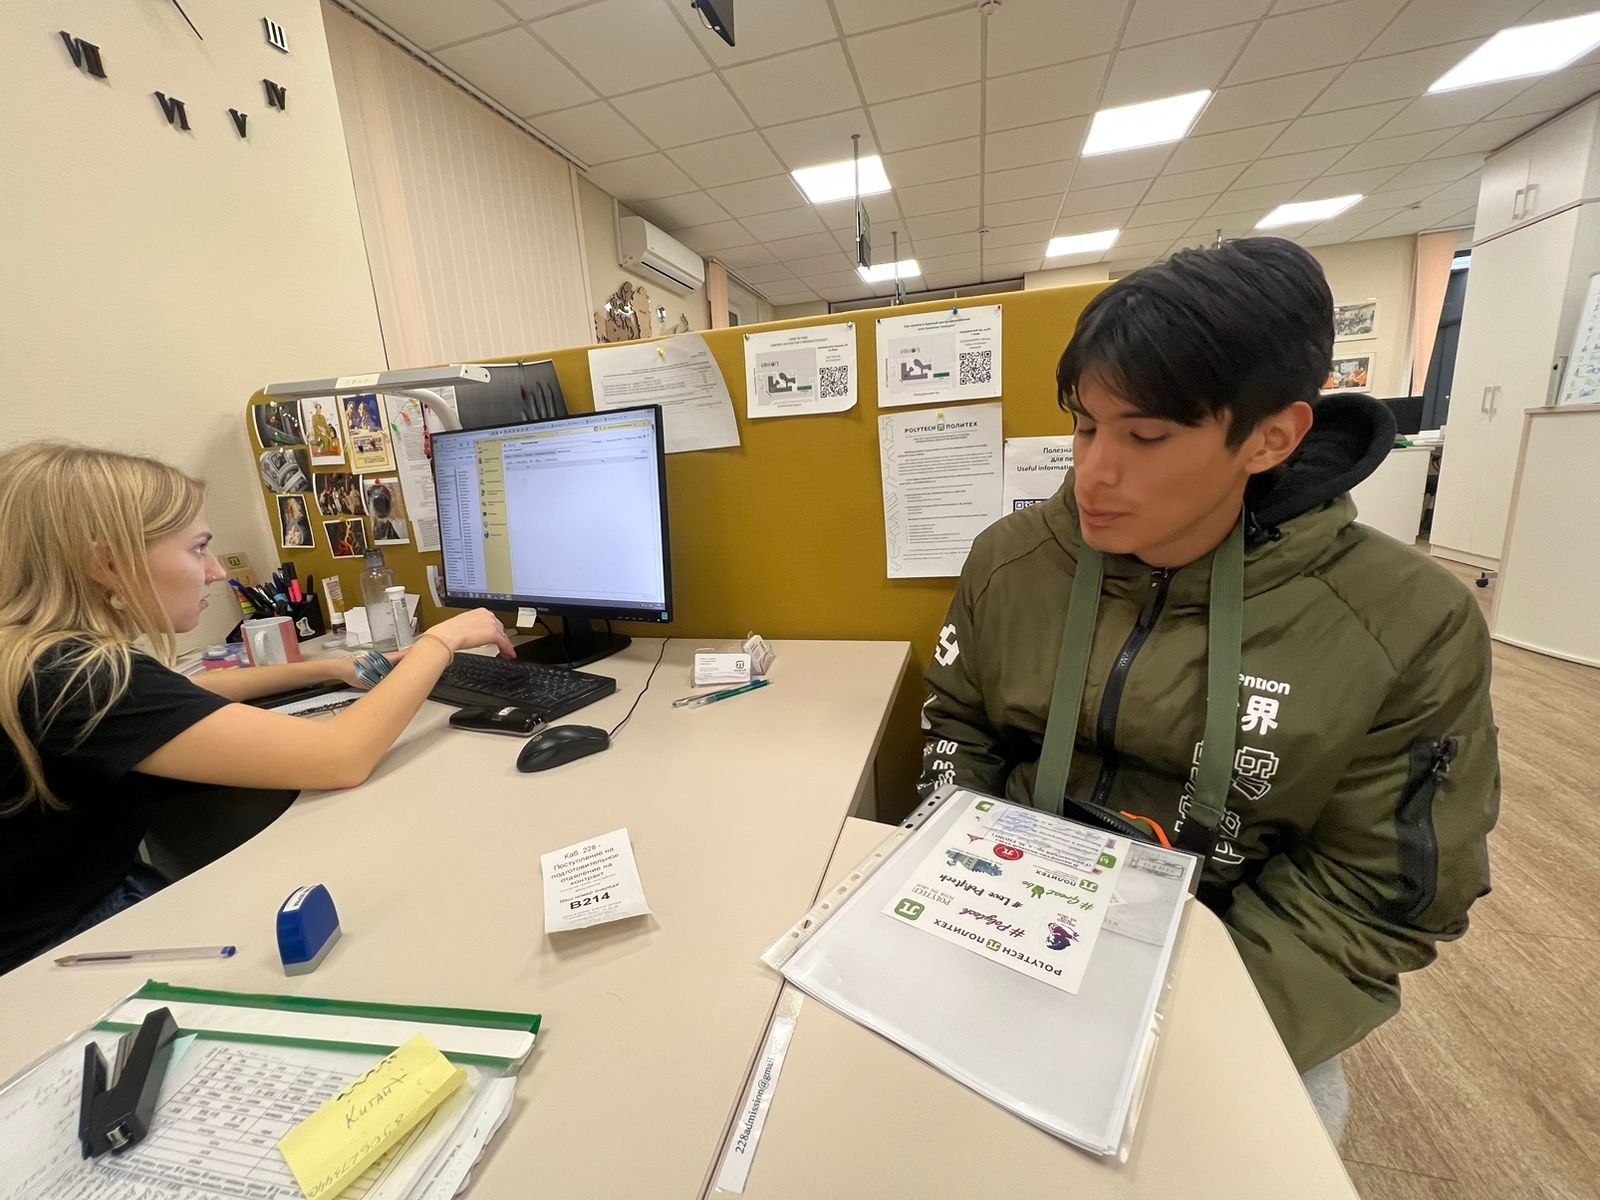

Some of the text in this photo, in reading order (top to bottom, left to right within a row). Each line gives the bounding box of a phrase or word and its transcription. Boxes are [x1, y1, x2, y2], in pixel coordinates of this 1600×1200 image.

[262, 17, 290, 54] III
[262, 78, 287, 110] IV
[154, 90, 191, 130] VI
[229, 108, 248, 138] V
[904, 425, 936, 434] POLYTECH
[946, 421, 978, 429] ПОЛИТЕХ
[1241, 695, 1280, 735] 界
[551, 853, 620, 879] подготовительное
[553, 850, 604, 870] Поступление
[560, 866, 601, 883] отделение
[570, 872, 604, 886] контракт
[939, 873, 985, 900] Polytech
[1035, 870, 1076, 886] ПОЛИТЕХ
[988, 892, 1011, 908] Love
[934, 918, 985, 944] ПОЛИТЕХ
[958, 907, 1026, 939] #Polytech
[1002, 946, 1062, 976] POLYTECH
